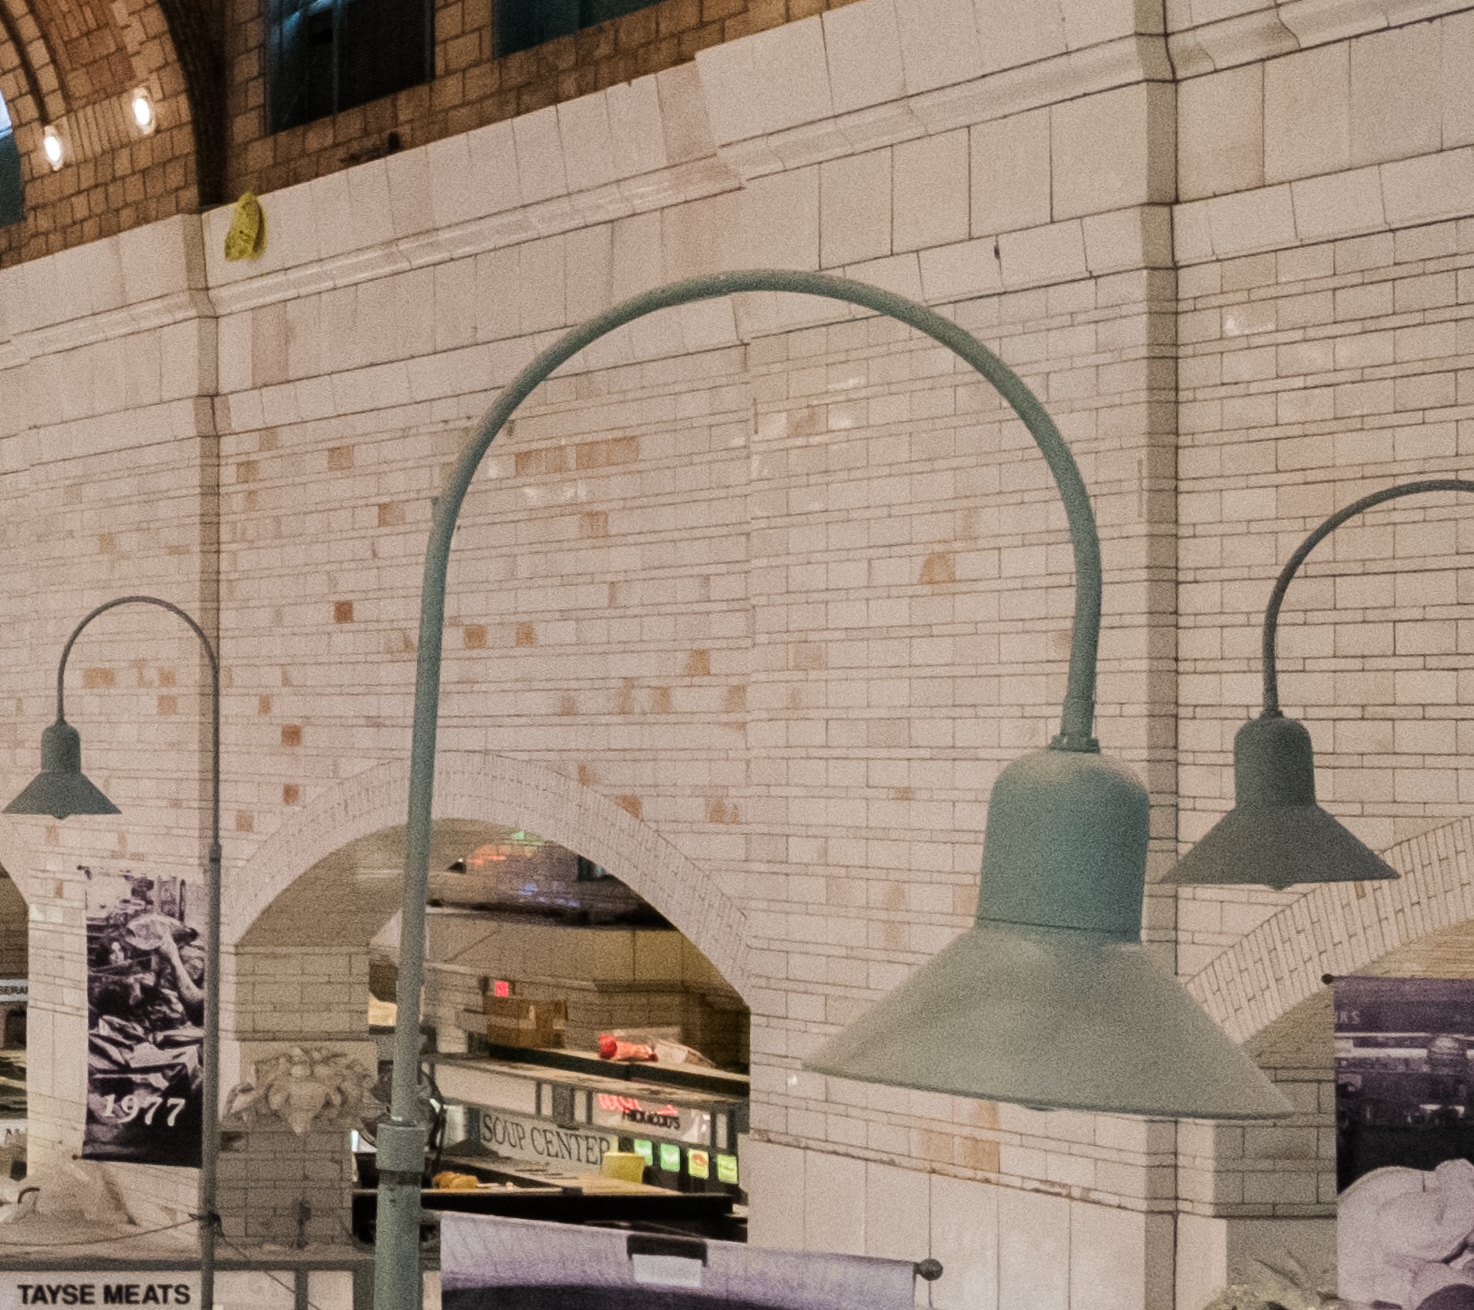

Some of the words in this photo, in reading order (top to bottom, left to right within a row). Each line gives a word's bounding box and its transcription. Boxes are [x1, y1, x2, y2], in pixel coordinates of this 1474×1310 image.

[101, 1092, 185, 1128] 1977
[481, 1113, 527, 1152] SOUP
[530, 1125, 612, 1165] CENTER
[17, 1283, 99, 1307] TAYSE
[103, 1282, 191, 1307] MEATS
